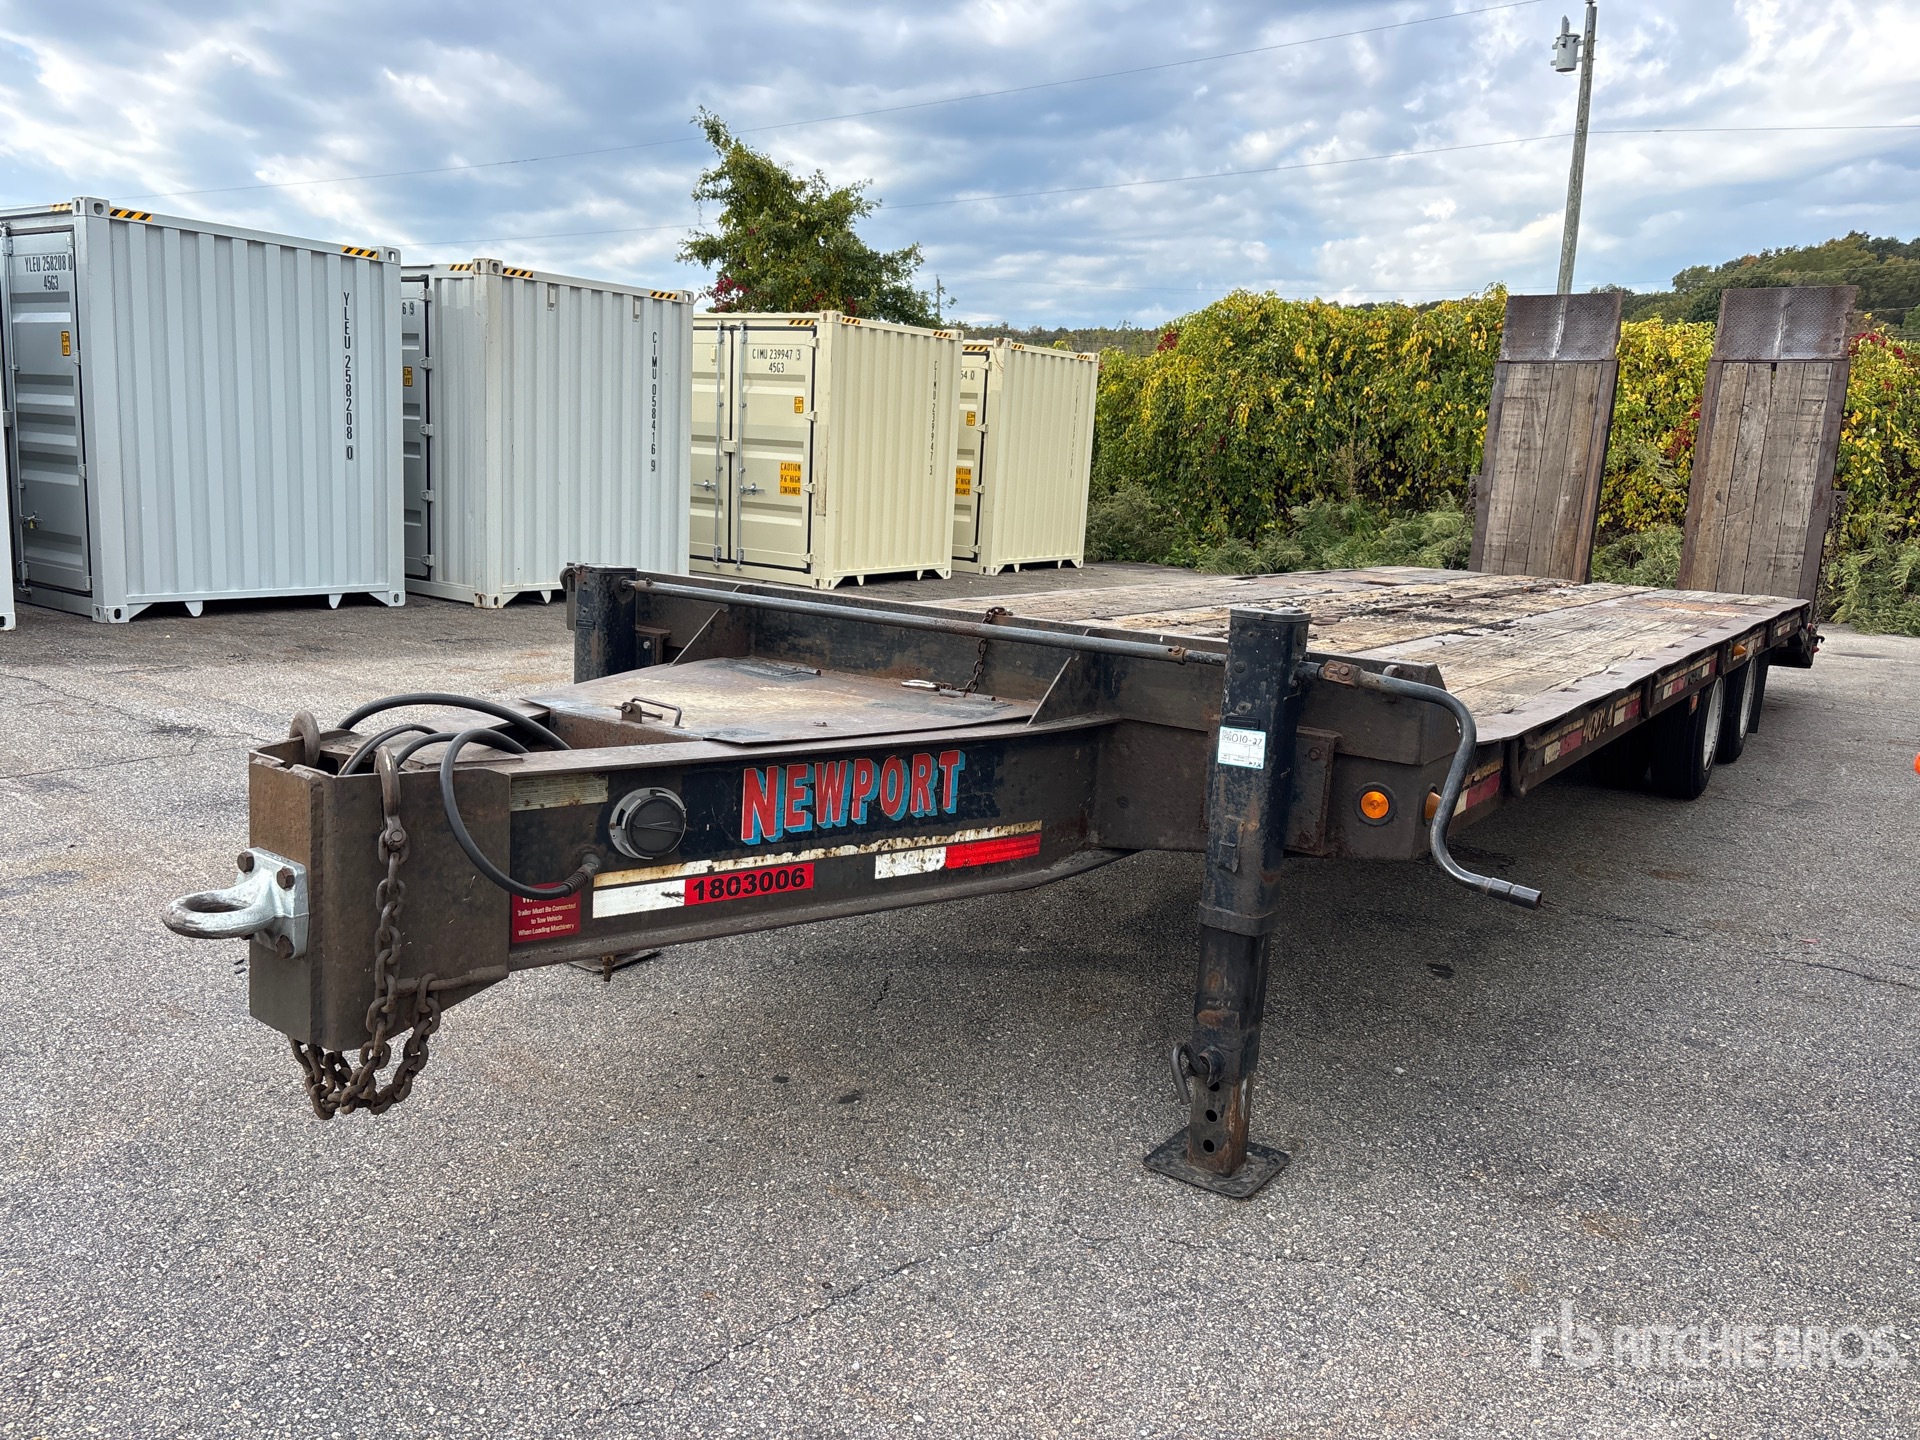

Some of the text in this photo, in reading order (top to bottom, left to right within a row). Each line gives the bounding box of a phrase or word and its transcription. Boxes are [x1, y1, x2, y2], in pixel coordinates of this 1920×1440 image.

[25, 256, 41, 272] YLEU
[42, 255, 67, 271] 258208
[43, 275, 59, 290] 45G3
[752, 348, 768, 360] CIMU
[769, 349, 793, 360] 239947
[768, 362, 785, 373] 45G3
[741, 749, 966, 846] NEWPORT
[692, 866, 806, 901] 1803006
[552, 903, 576, 912] Connected
[536, 916, 547, 924] Tow
[547, 914, 563, 923] Vehicle
[518, 923, 574, 936] When Loading Machinery
